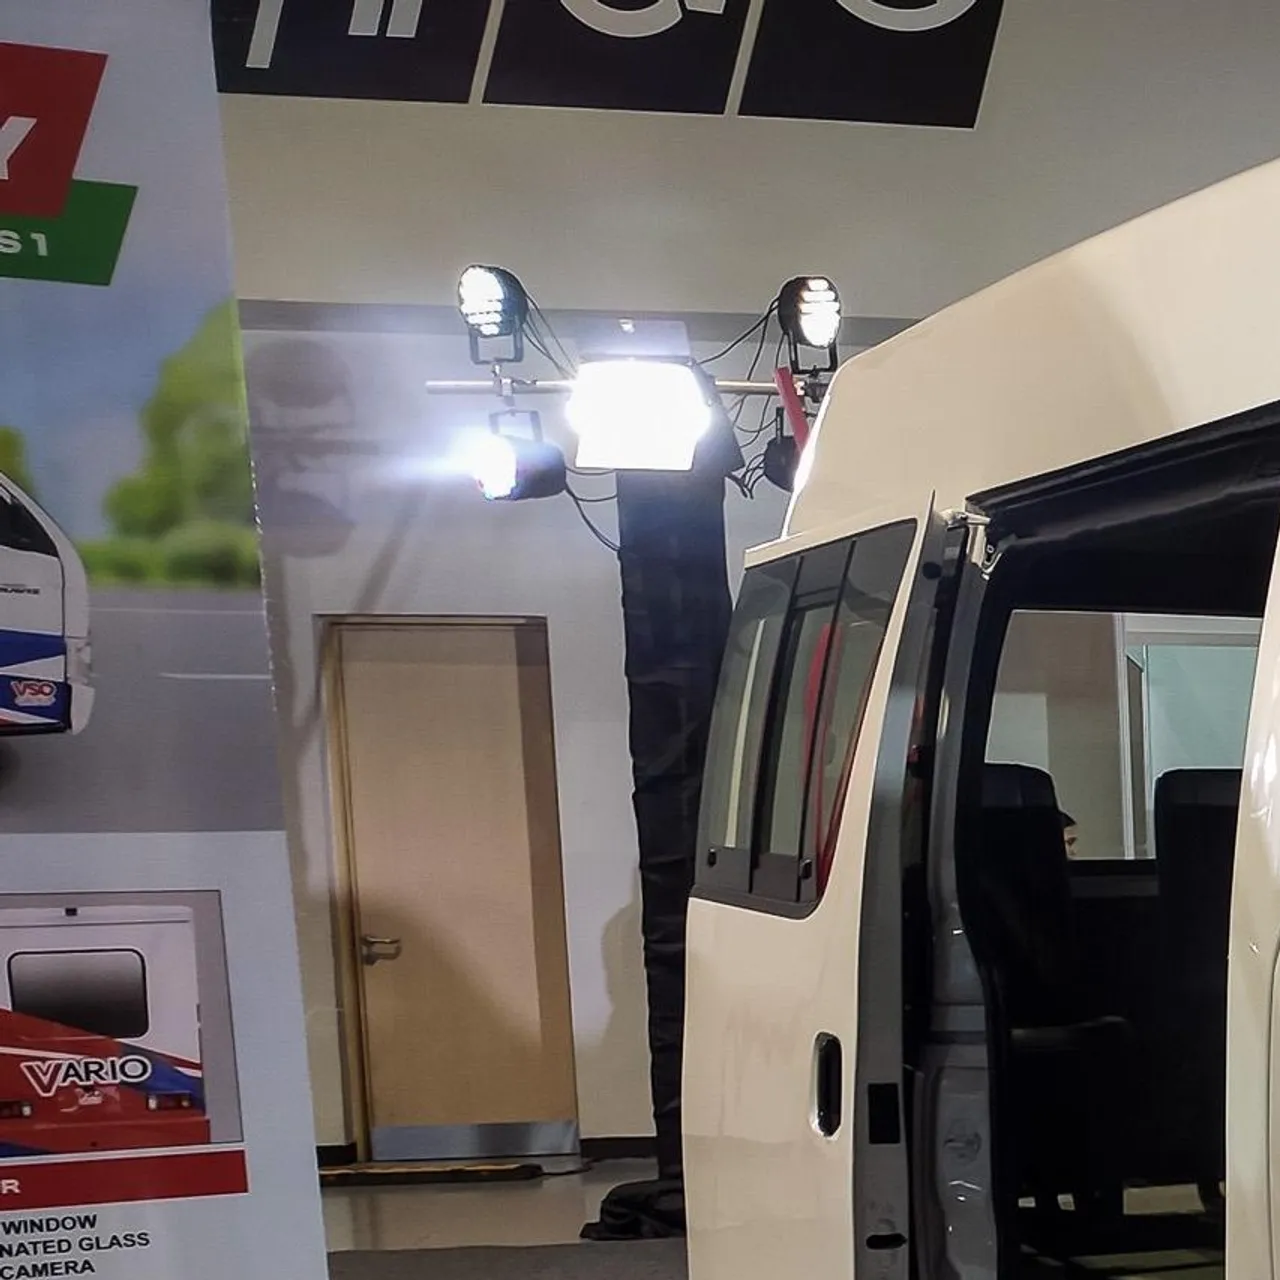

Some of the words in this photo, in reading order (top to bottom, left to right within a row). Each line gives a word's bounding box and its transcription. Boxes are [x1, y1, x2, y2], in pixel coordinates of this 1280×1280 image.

[11, 681, 57, 697] VSO
[20, 1055, 152, 1097] VARIO
[1, 1214, 98, 1235] WINDOW
[78, 1232, 150, 1252] GLASS
[0, 1259, 96, 1280] CAMERA
